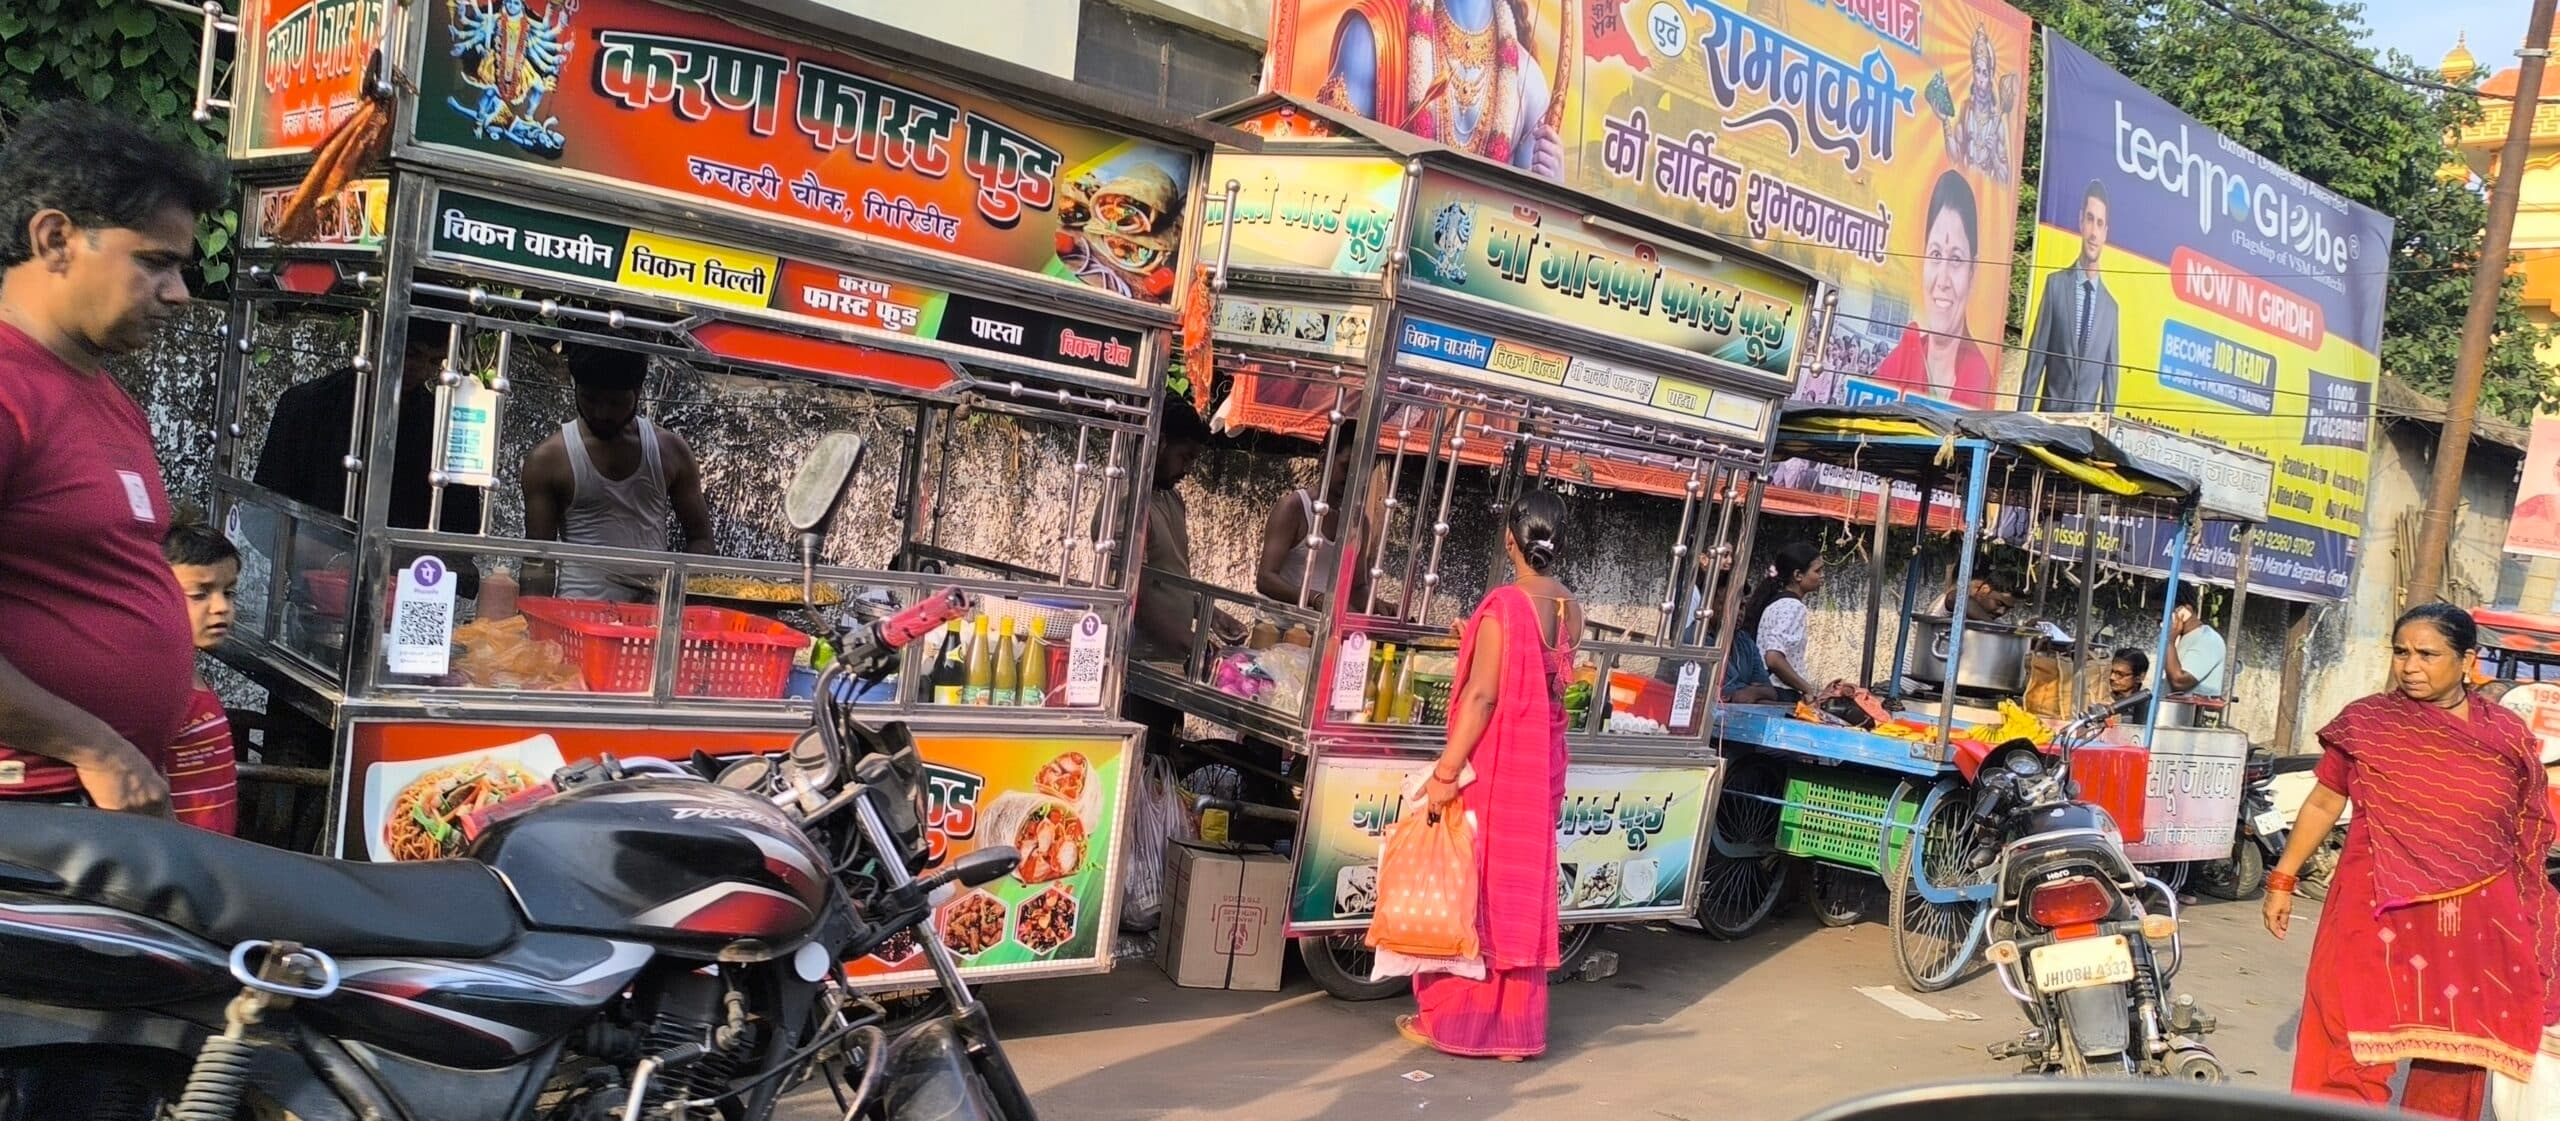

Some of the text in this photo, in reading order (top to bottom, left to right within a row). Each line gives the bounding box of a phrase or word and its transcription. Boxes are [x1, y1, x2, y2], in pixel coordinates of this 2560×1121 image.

[1654, 15, 1681, 47] एवं
[1688, 0, 1914, 169] रामनवमी
[598, 29, 1064, 224] करण फास्ट फुड
[1604, 109, 1649, 182] की
[1655, 131, 1742, 210] हार्दिक
[687, 156, 962, 242] कचहरी चौक, गिरिडीह
[443, 207, 614, 270] चिकन चाउमीन
[631, 245, 768, 296] चिकन चिल्ली
[838, 273, 892, 300] करण
[1539, 242, 1664, 316] जानकी
[1659, 272, 1741, 336] फास्ट
[802, 284, 921, 332] फास्ट फुड
[2185, 258, 2315, 341] NOW IN GIRIDIH
[970, 314, 1025, 346] पास्ता
[1060, 328, 1103, 362] चिकन
[1402, 324, 1487, 364] चिकन चाउमीन
[1493, 346, 1528, 373] चिकन
[2164, 333, 2271, 387] BECOME JOB READY
[2326, 382, 2359, 414] 100%
[2308, 405, 2367, 443] Placement
[2046, 869, 2070, 881] Hero
